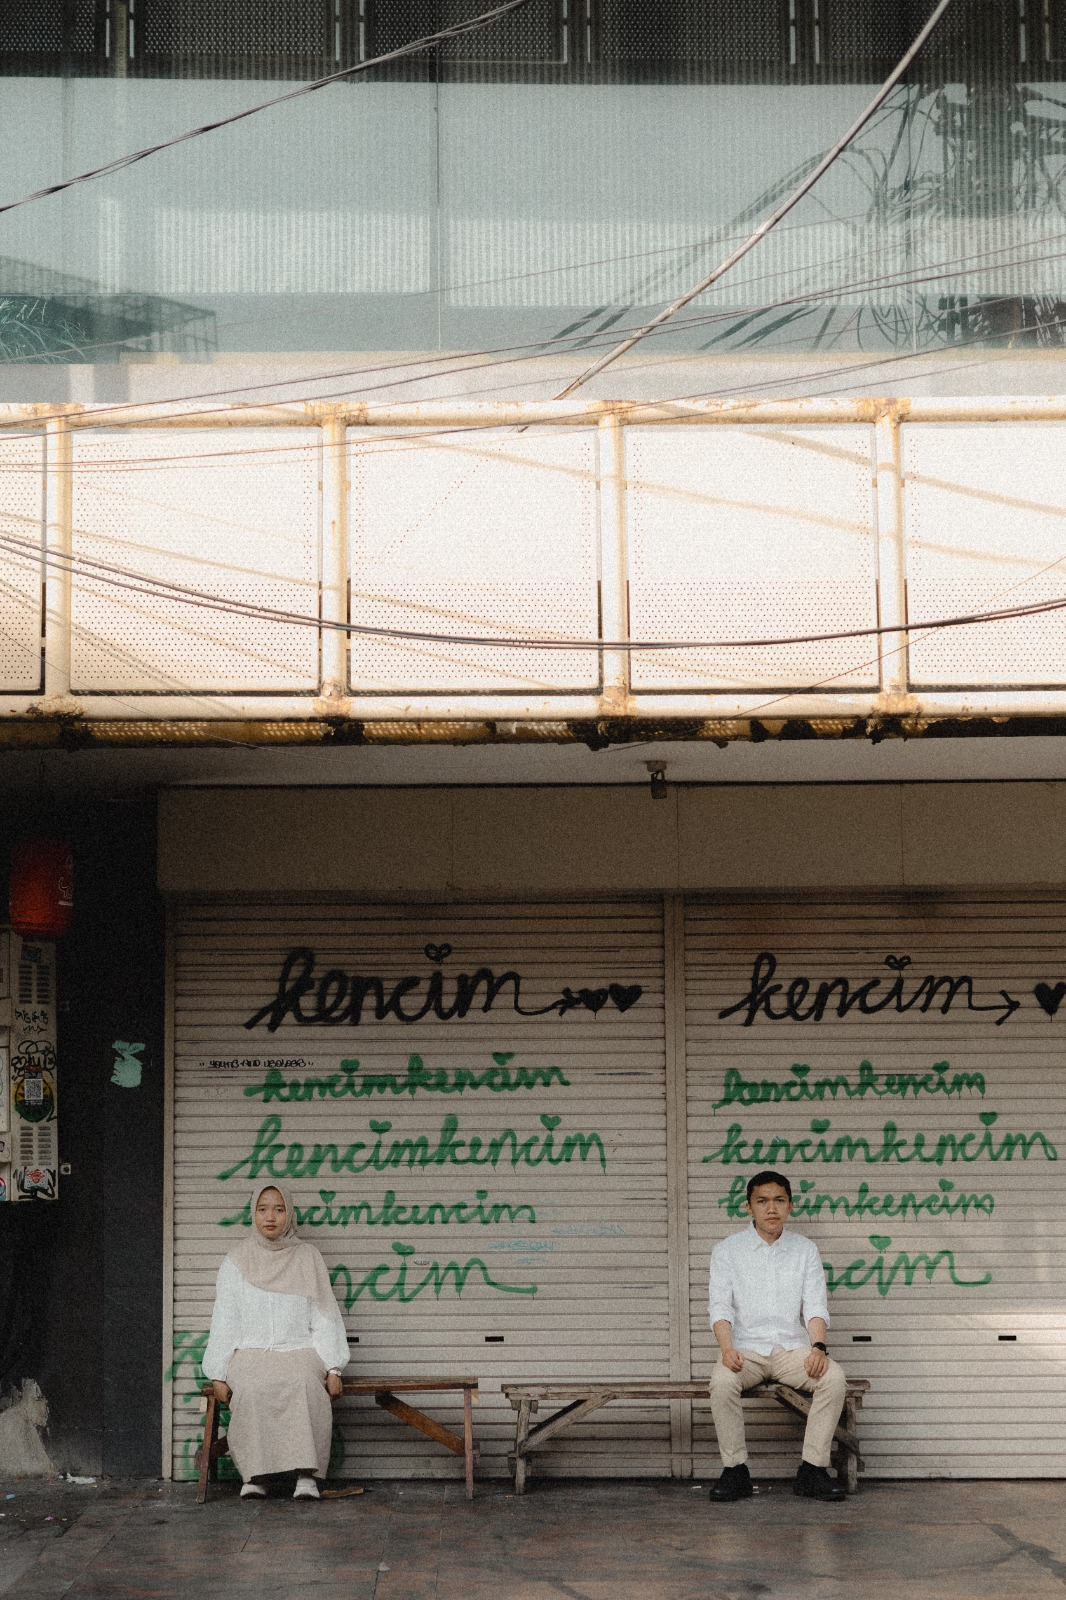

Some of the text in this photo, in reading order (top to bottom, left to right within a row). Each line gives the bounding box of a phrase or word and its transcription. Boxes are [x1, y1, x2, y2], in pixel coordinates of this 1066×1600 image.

[244, 942, 545, 1032] kencim
[718, 952, 985, 1028] kencim
[217, 1113, 607, 1180] kencimkencim
[702, 1111, 1059, 1166] kencimkencim
